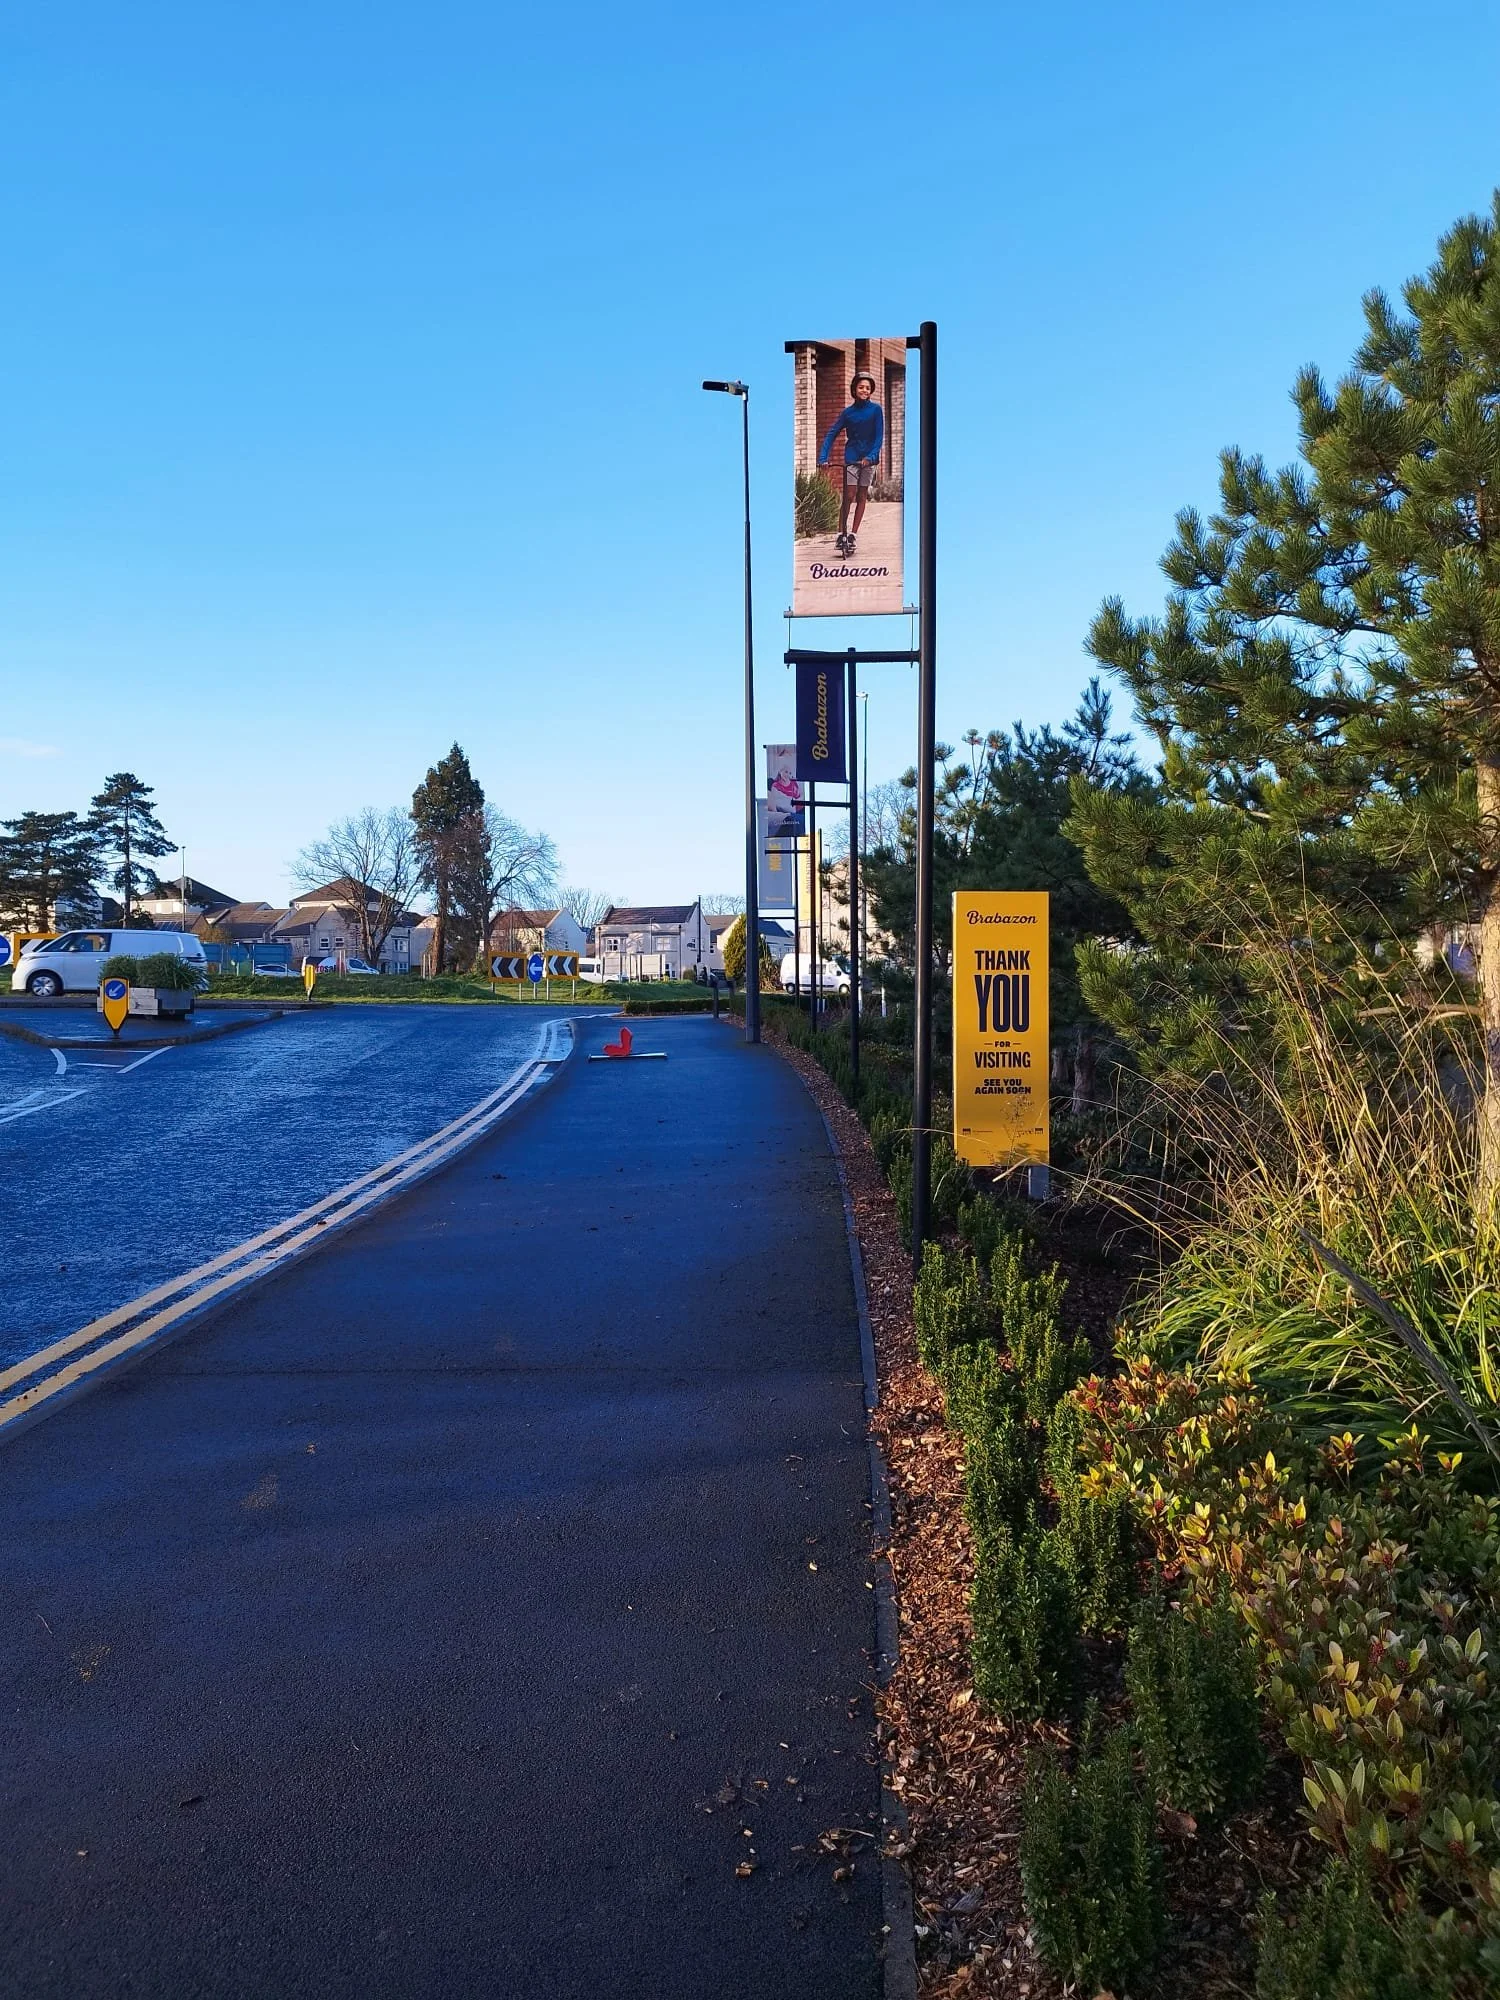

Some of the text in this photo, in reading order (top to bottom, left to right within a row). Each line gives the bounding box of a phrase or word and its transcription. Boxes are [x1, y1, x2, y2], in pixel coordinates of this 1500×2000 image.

[810, 562, 889, 580] Brabazon
[811, 672, 829, 761] Brabazon
[966, 910, 1038, 925] Brabazon
[974, 950, 1031, 971] THANK
[974, 974, 1030, 1033] YOU
[994, 1040, 1011, 1048] FOR
[974, 1051, 1031, 1068] VISITING
[974, 1086, 1032, 1095] AGAIN SOON
[983, 1078, 1022, 1087] SEE YOU
